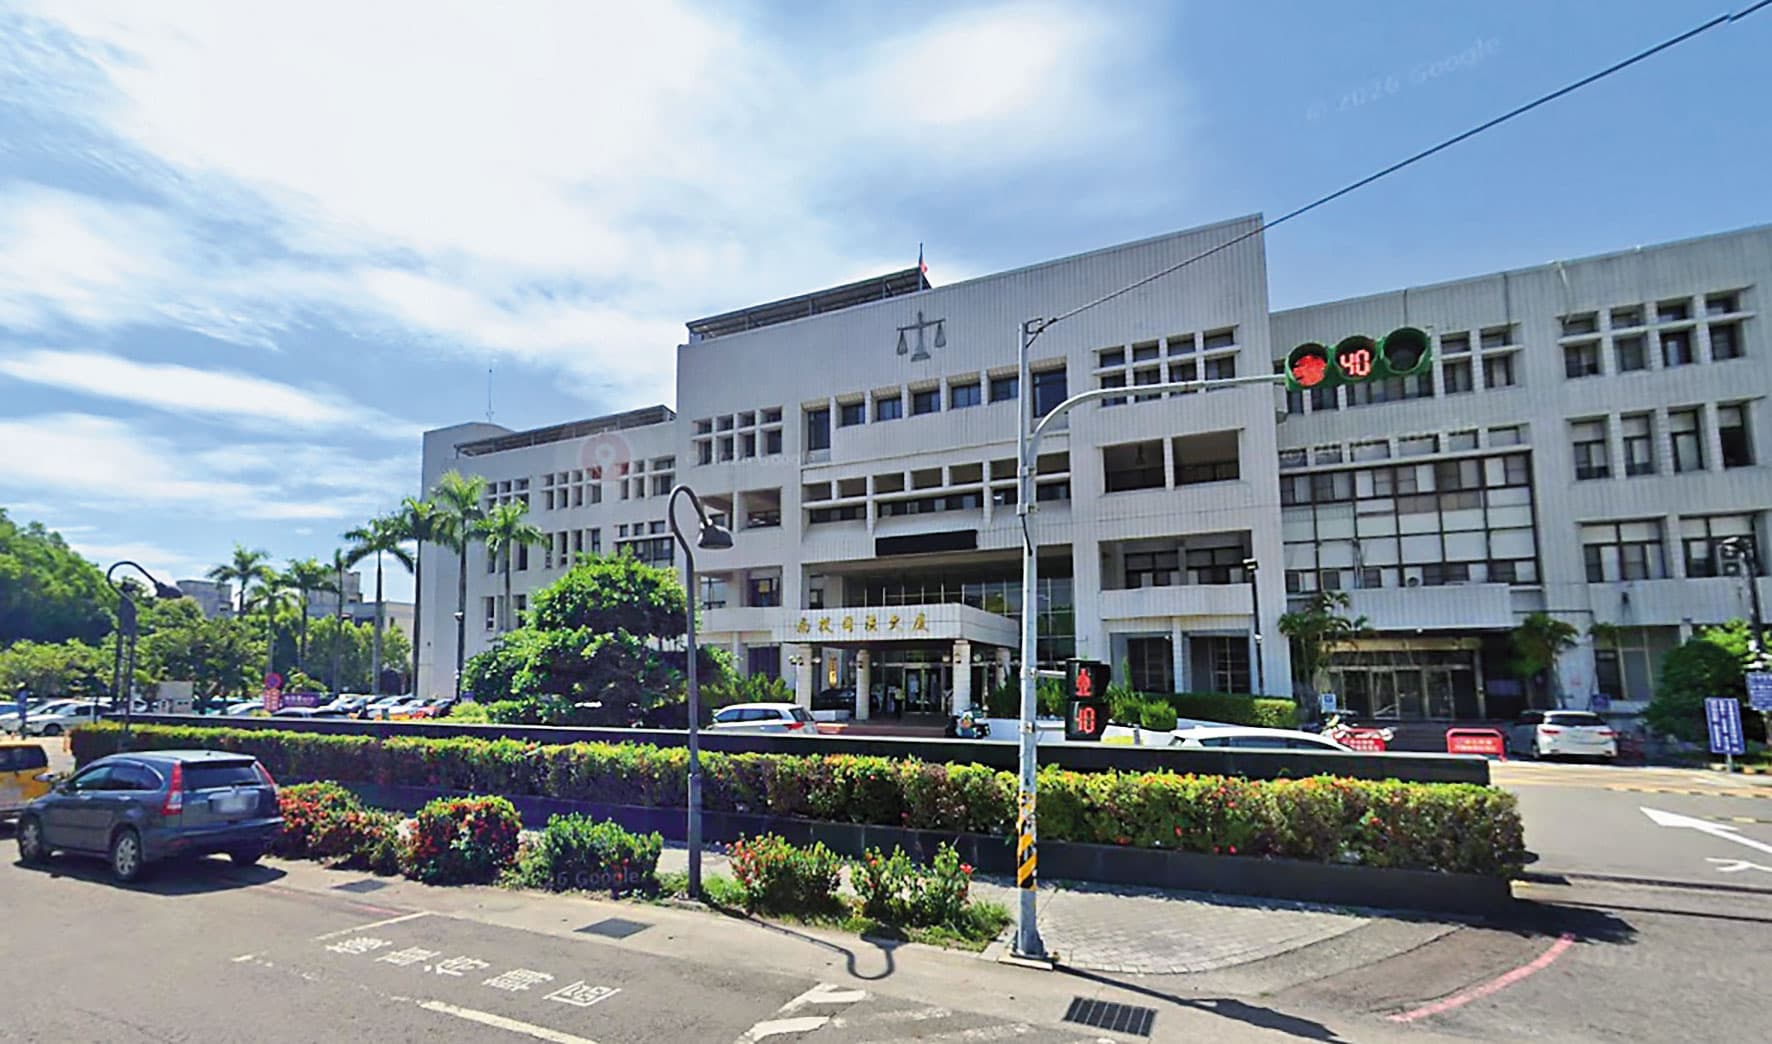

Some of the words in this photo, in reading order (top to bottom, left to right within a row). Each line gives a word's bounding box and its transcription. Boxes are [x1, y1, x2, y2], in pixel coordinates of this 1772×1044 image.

[1340, 349, 1372, 376] 40
[325, 936, 622, 1007] 機車待轉區
